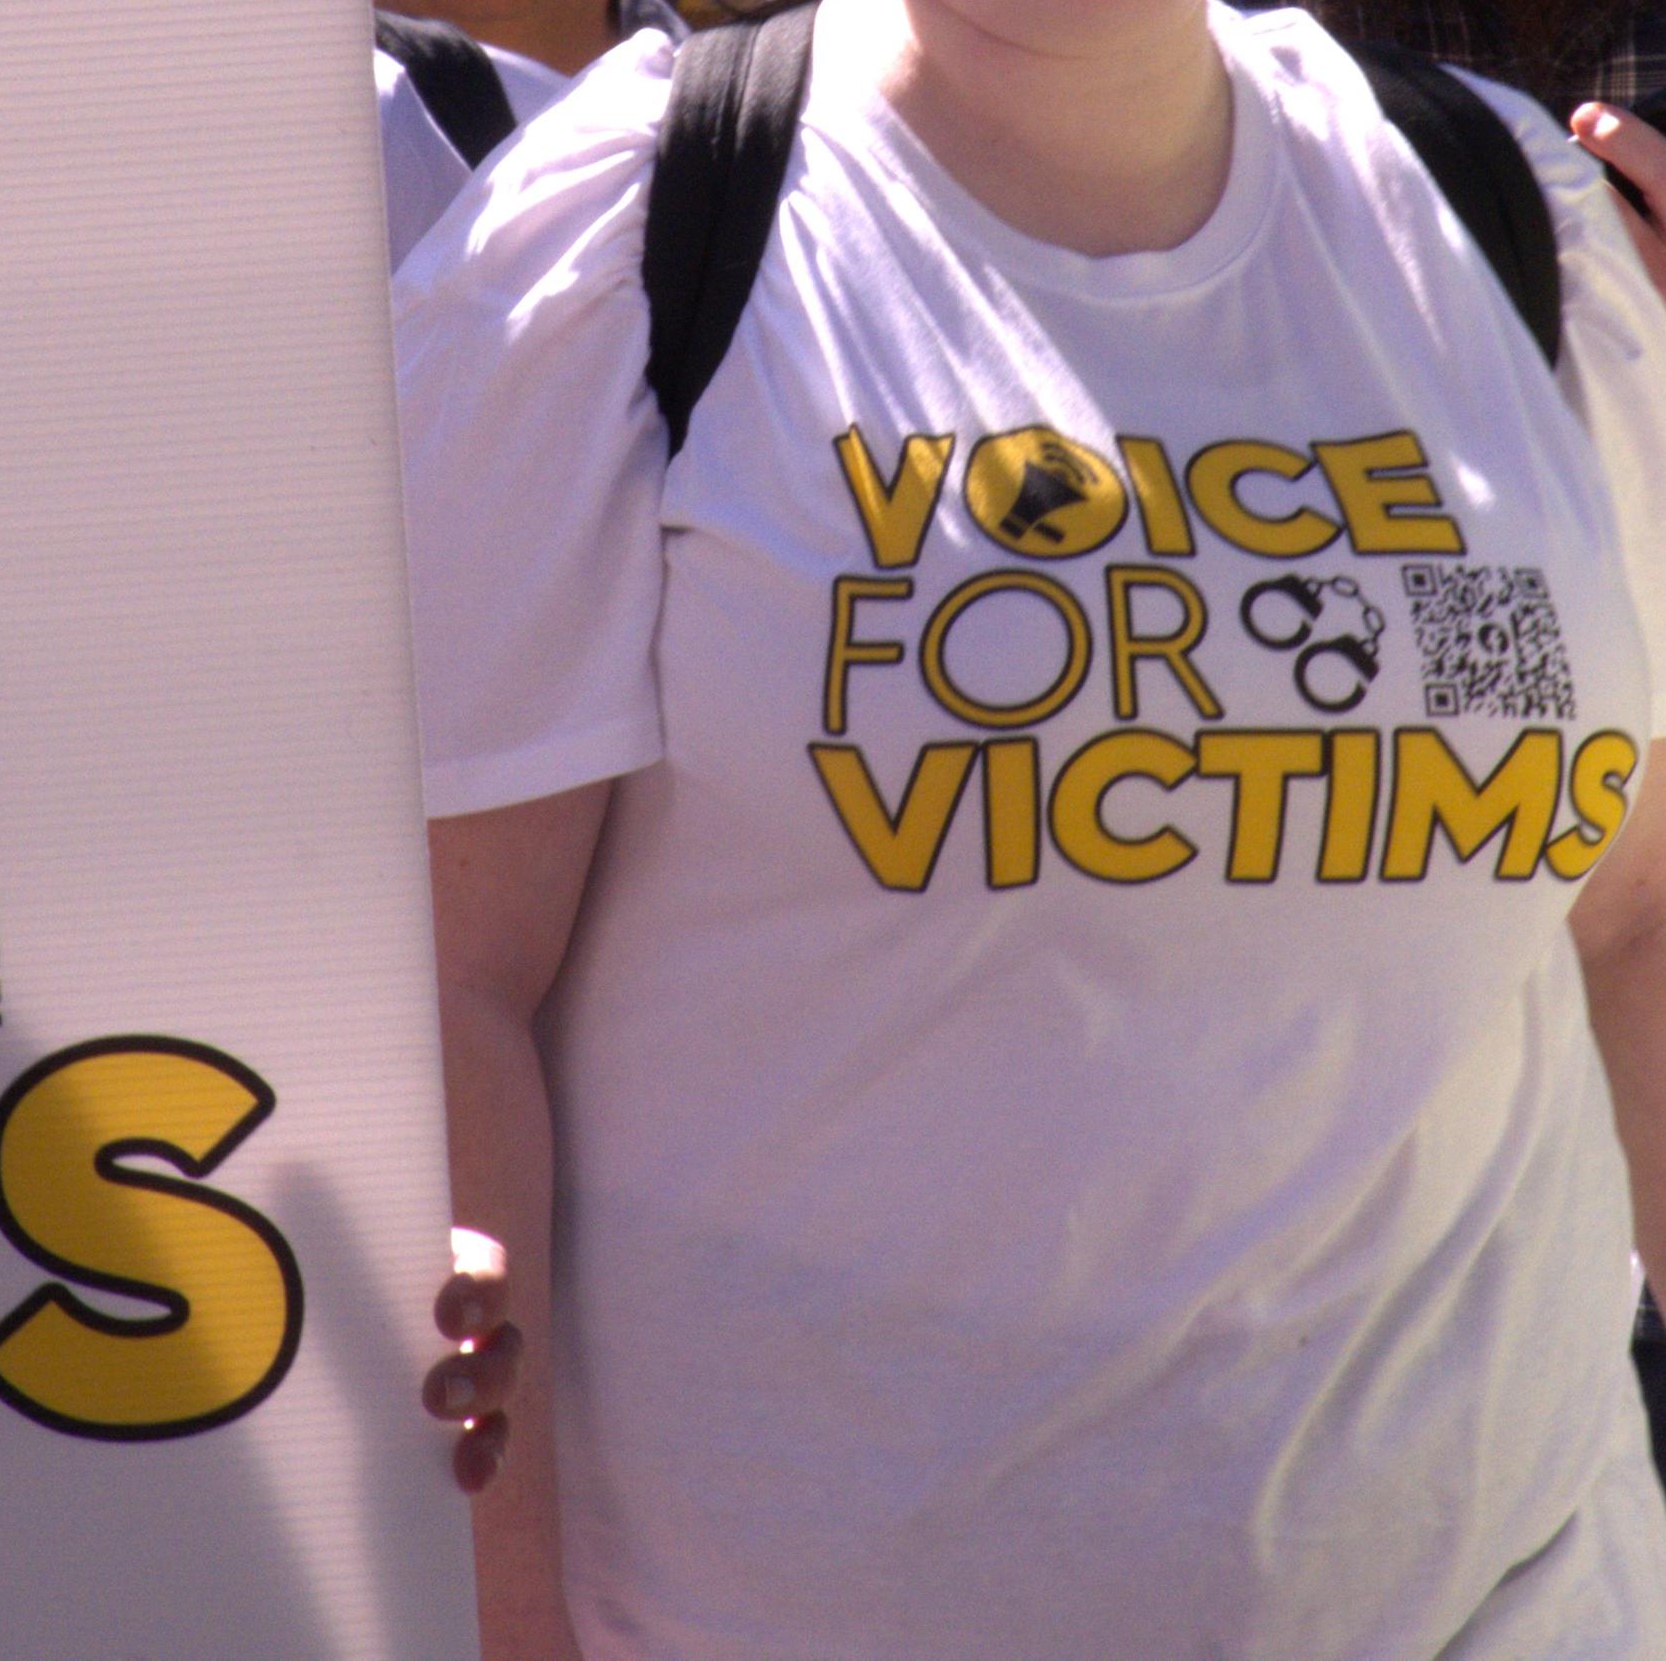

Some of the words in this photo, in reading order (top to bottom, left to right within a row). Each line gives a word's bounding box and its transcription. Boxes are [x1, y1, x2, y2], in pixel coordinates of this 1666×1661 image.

[831, 423, 1469, 569] VOICE
[822, 564, 1225, 735] FOR
[807, 725, 1639, 893] VICTIMS
